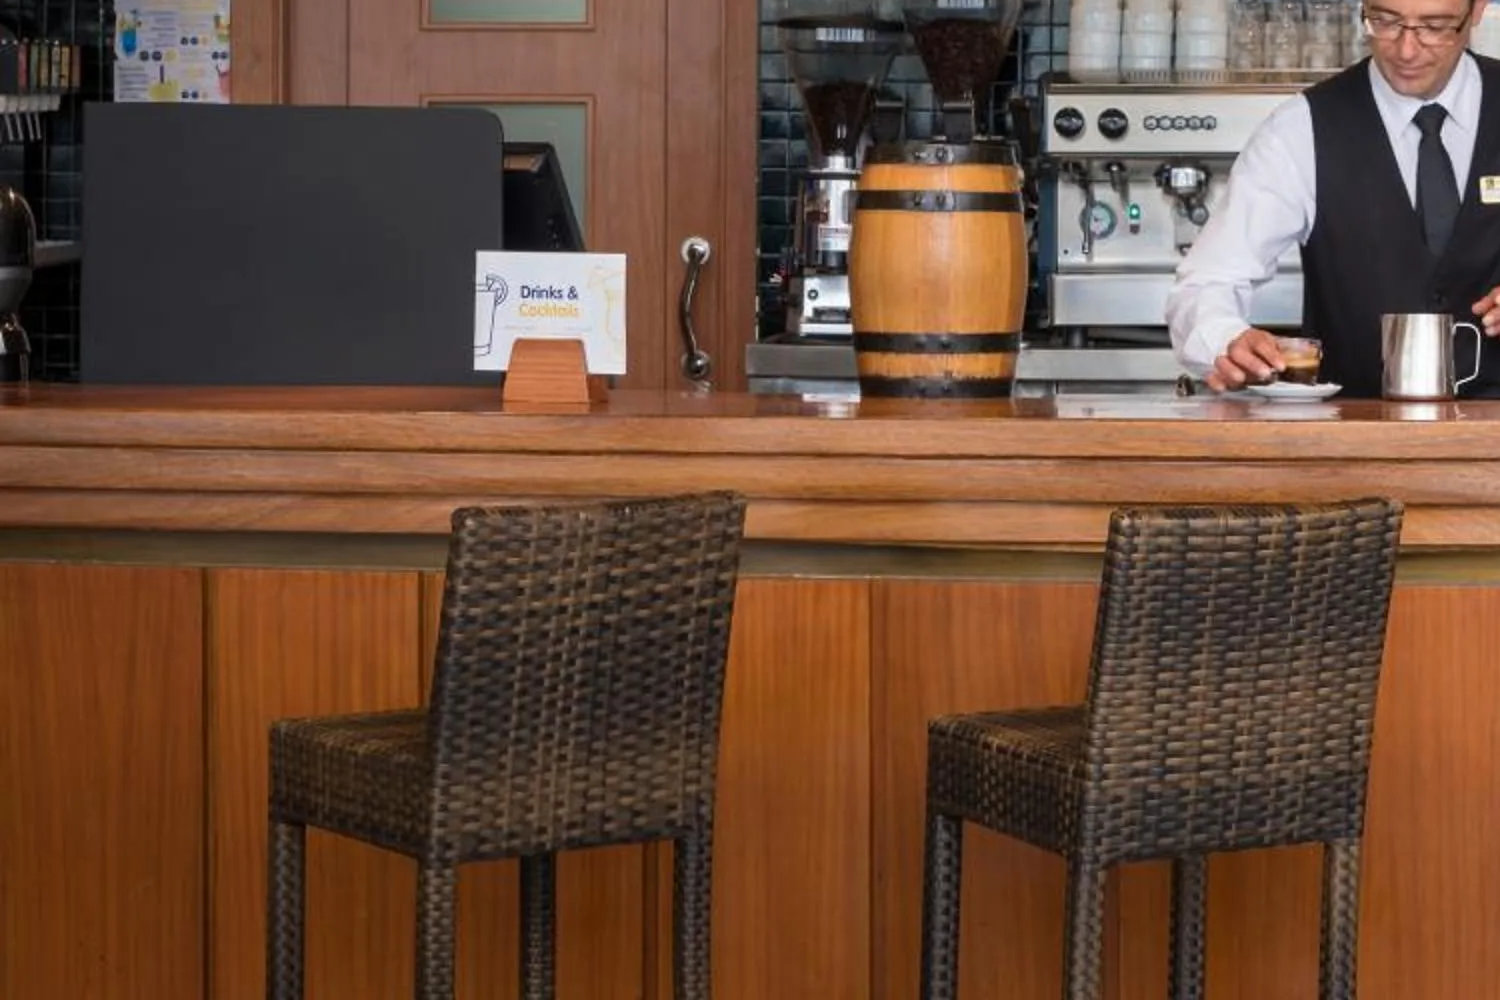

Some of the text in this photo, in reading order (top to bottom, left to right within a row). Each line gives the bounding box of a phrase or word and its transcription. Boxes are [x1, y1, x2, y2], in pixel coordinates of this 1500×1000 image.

[520, 285, 578, 299] Drinks &
[519, 303, 578, 316] Cocktails
